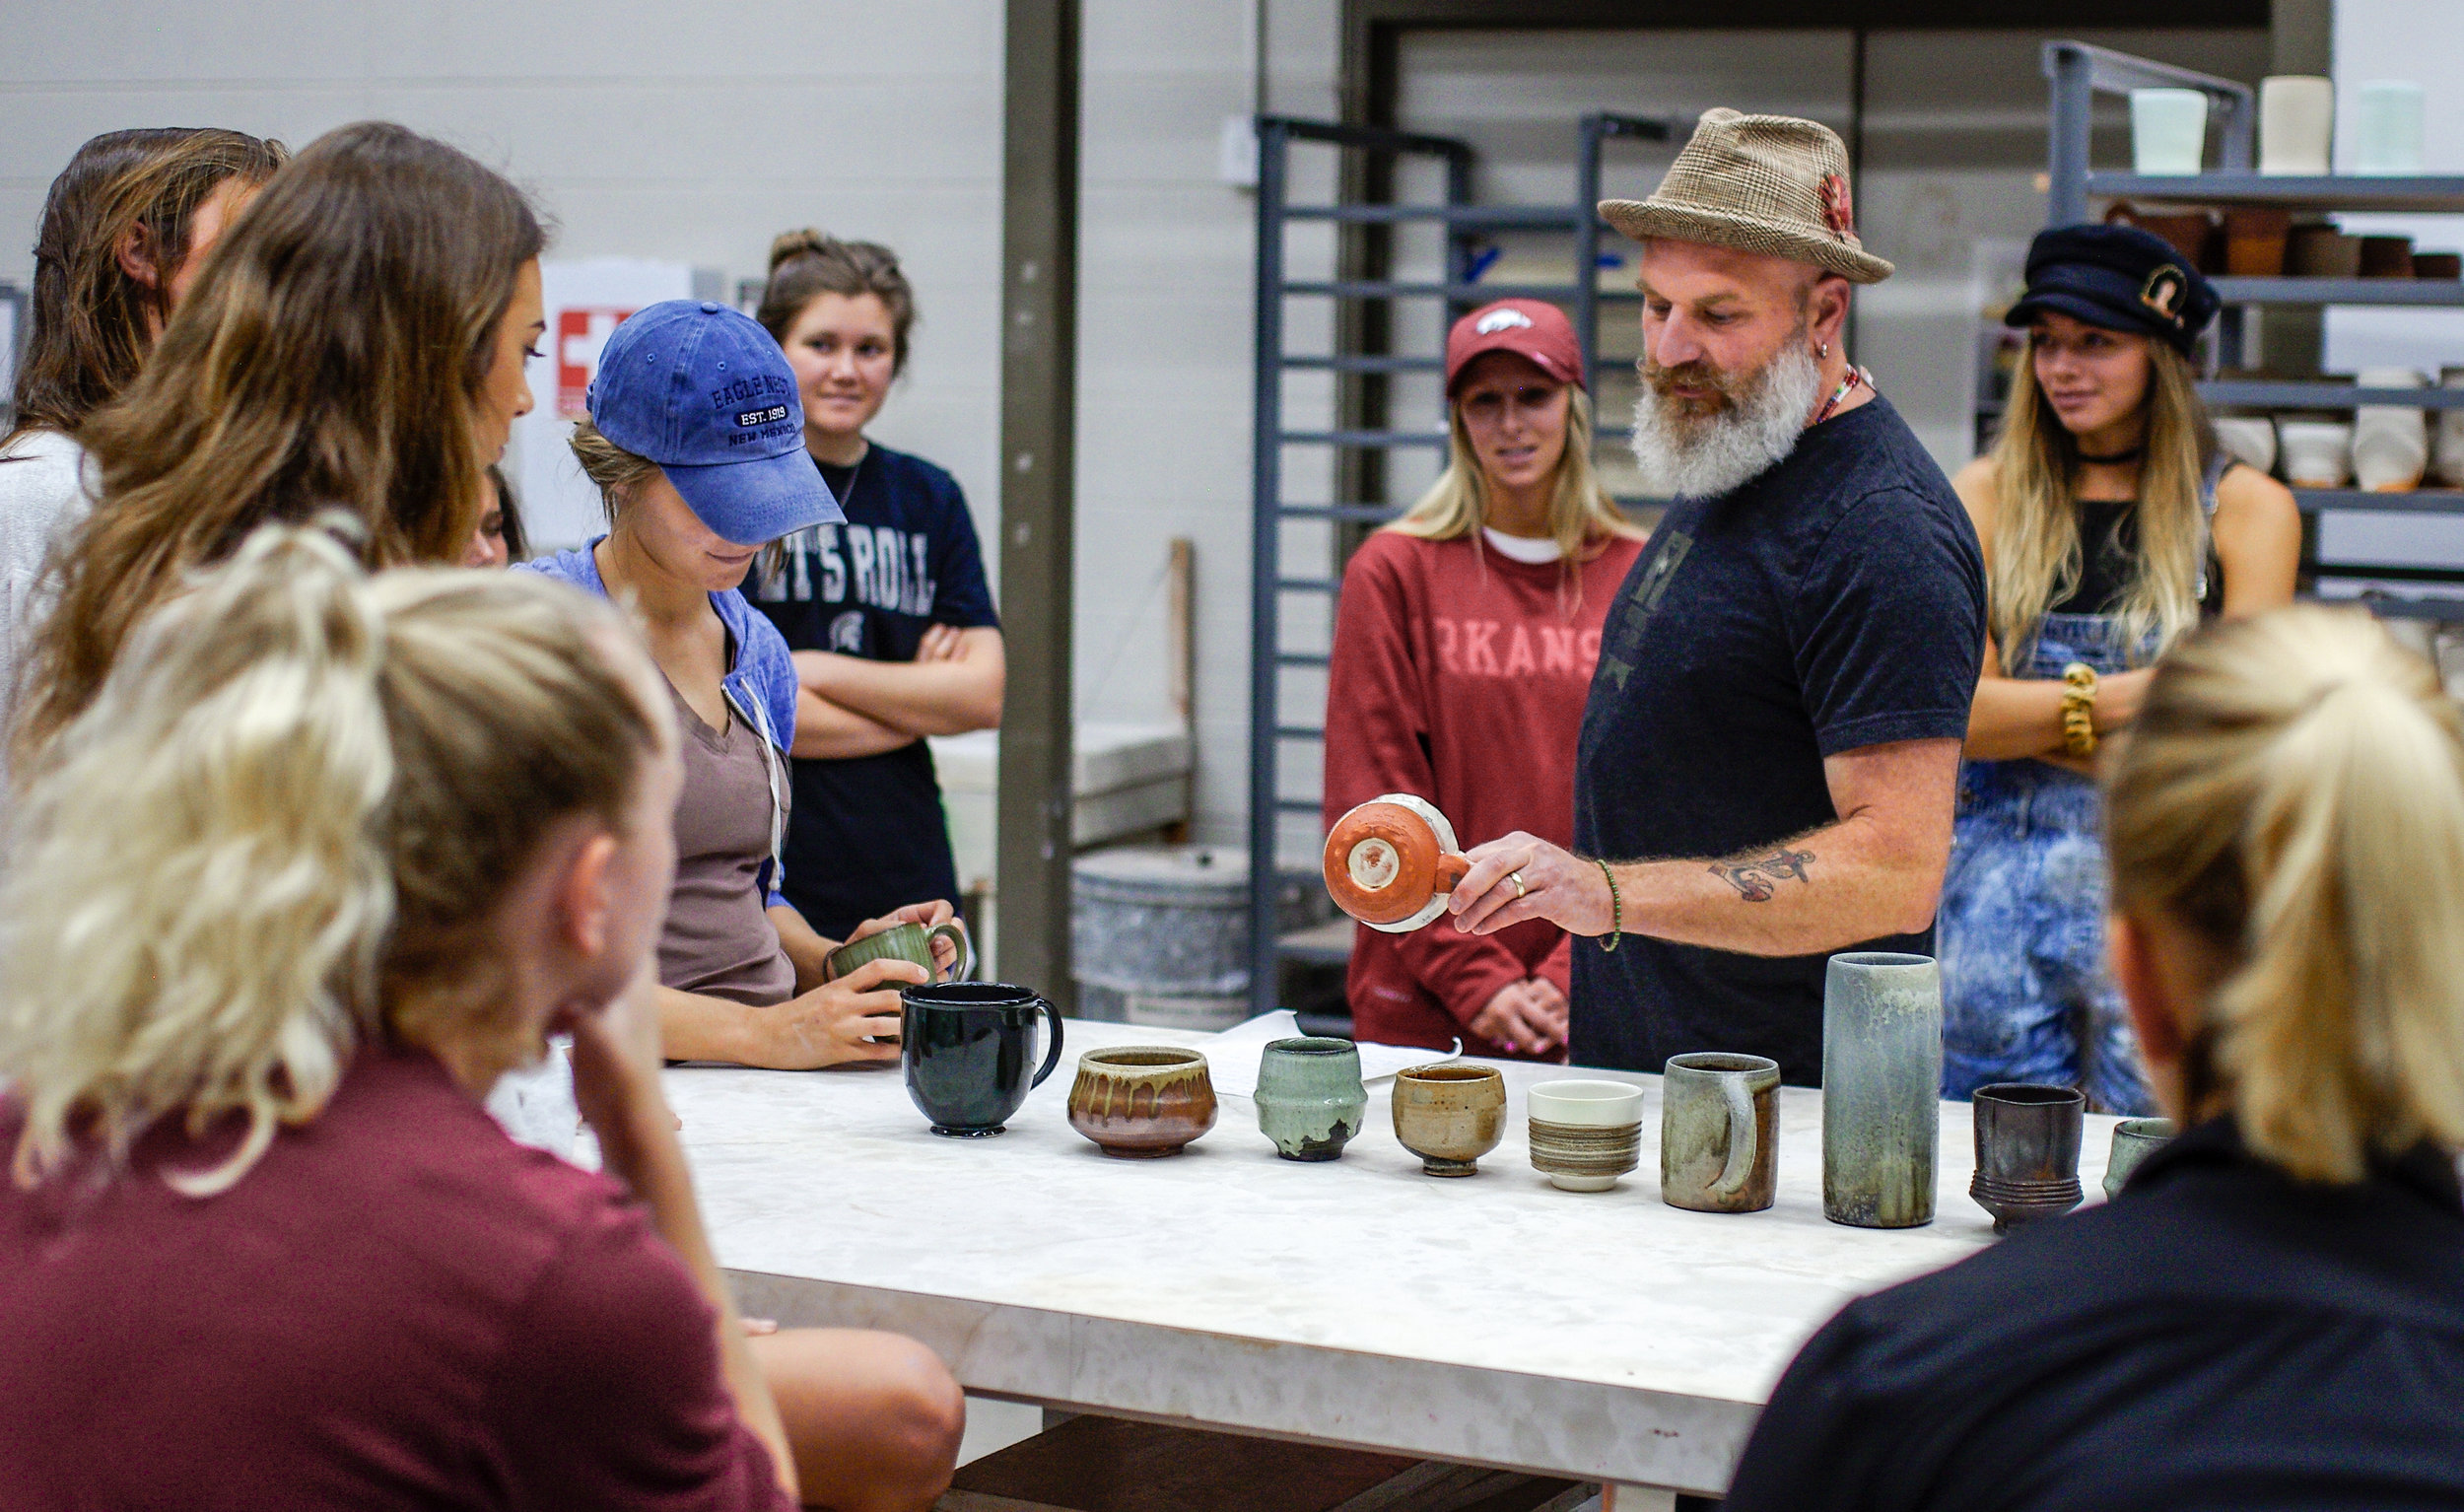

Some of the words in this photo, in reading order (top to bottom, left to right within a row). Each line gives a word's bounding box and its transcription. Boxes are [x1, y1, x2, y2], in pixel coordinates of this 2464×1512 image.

[712, 377, 764, 409] EAGLE
[740, 411, 767, 426] EST.
[768, 405, 787, 421] 1919
[729, 432, 756, 447] NEW
[760, 423, 795, 440] MEXICO
[846, 523, 936, 617] ROLL
